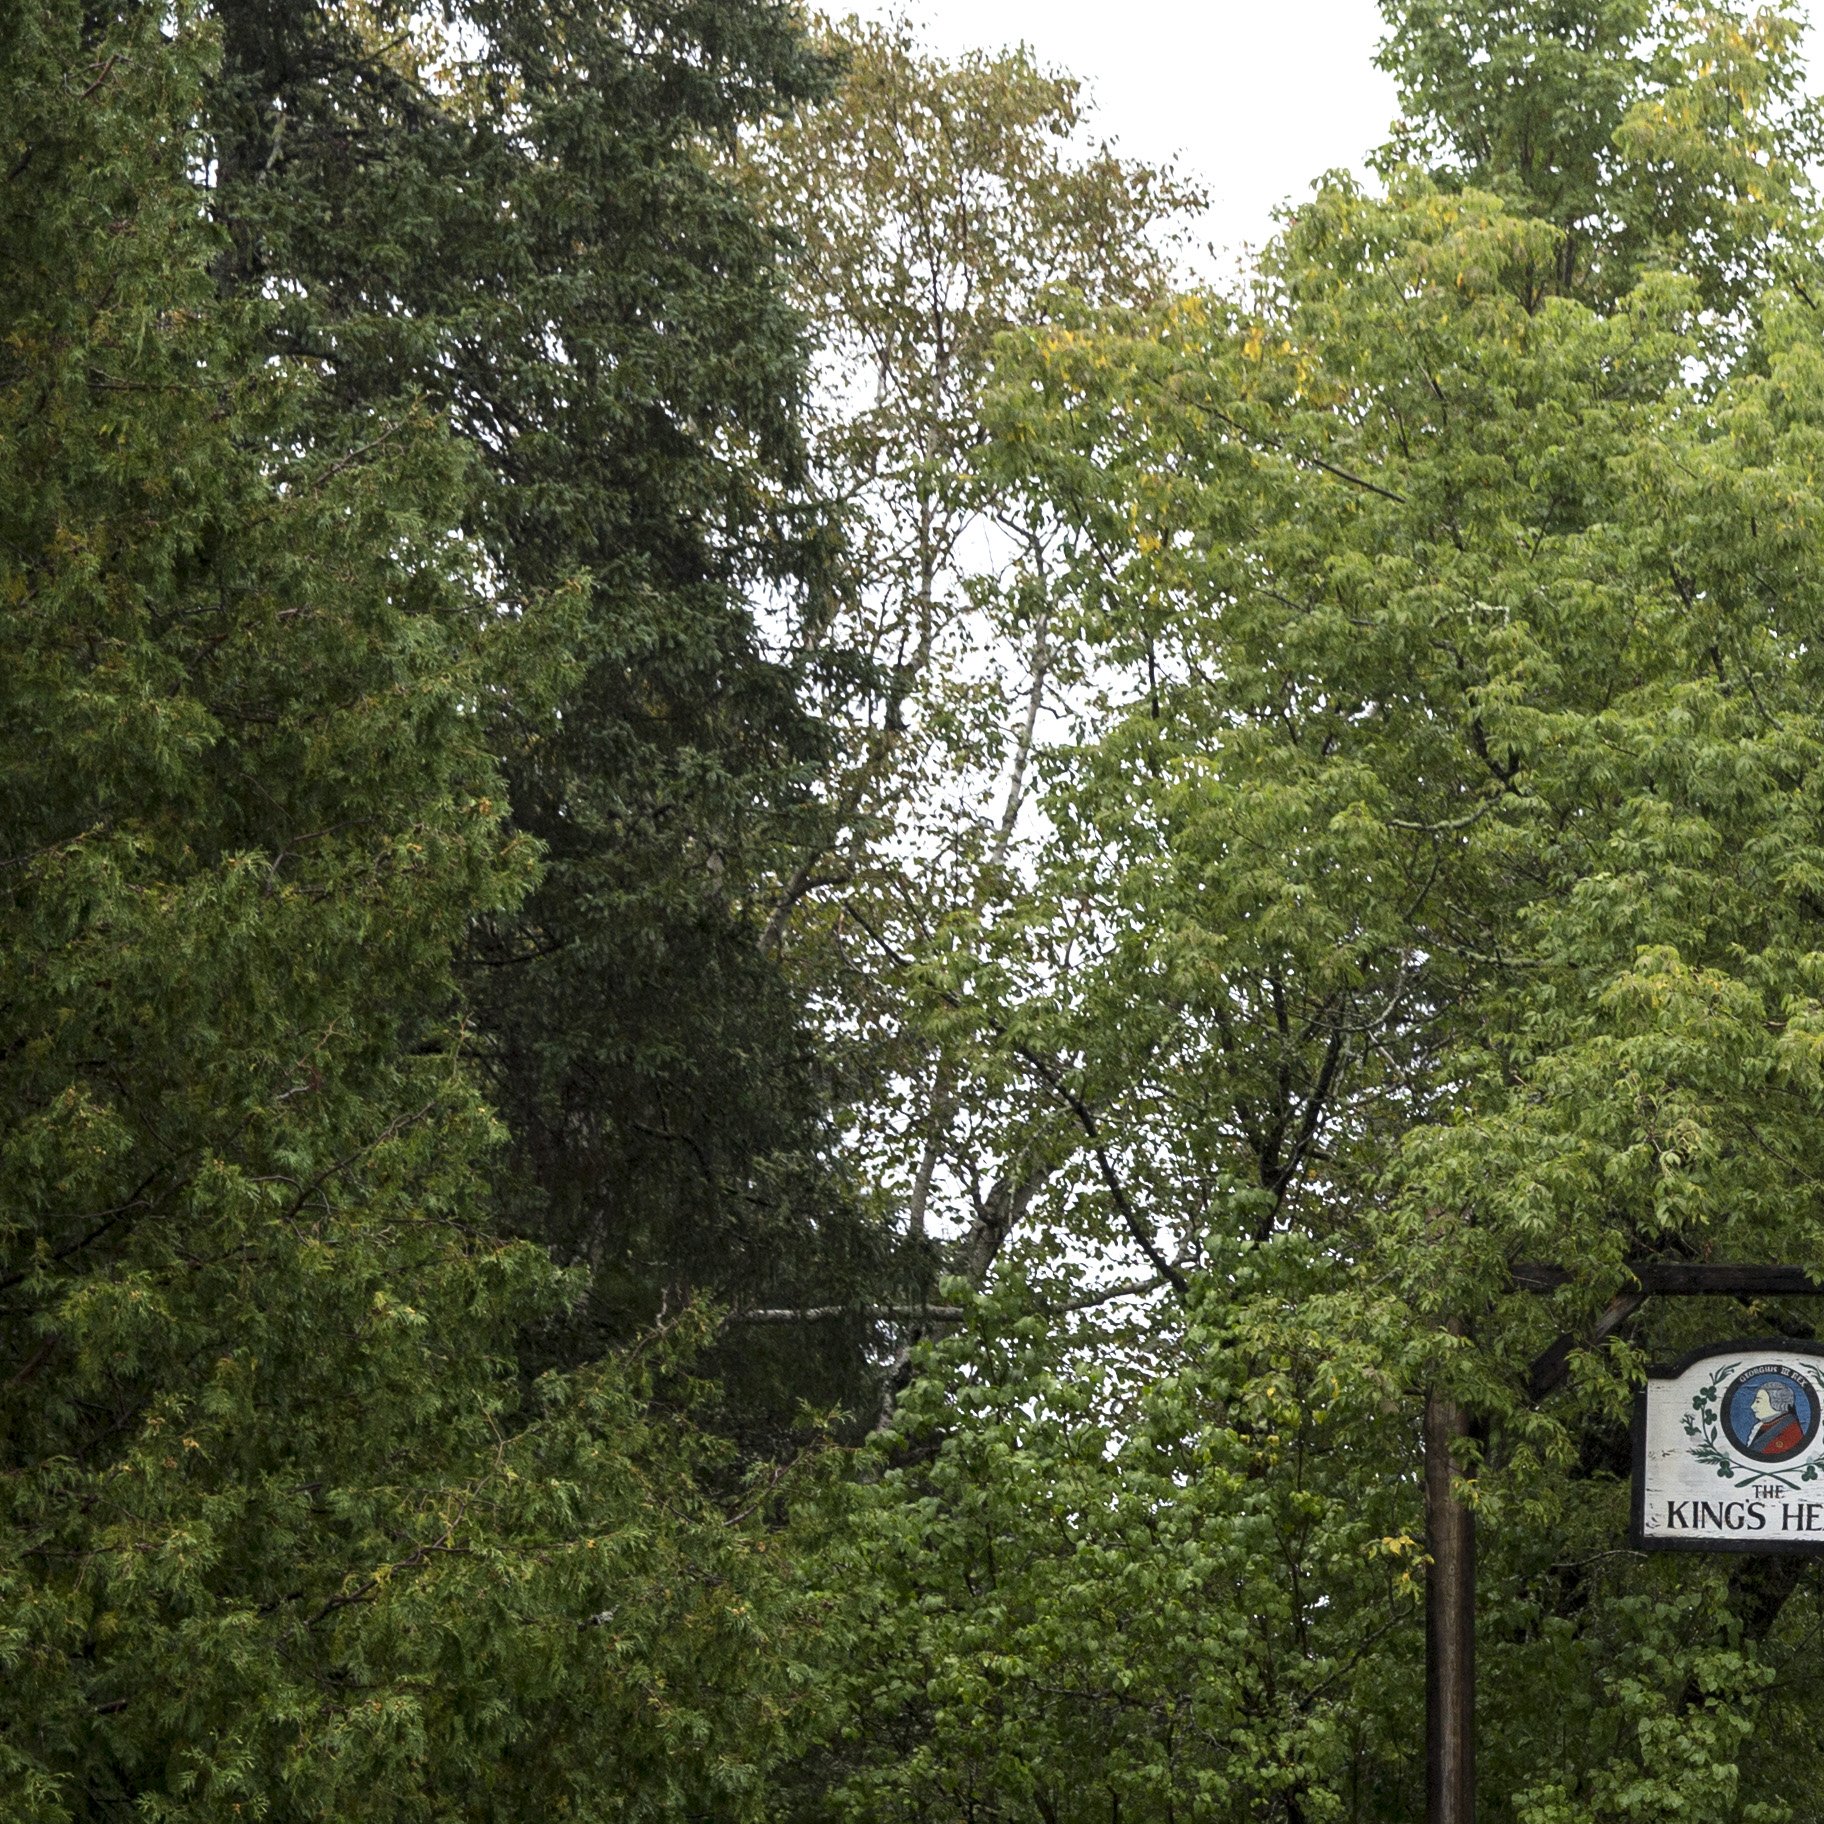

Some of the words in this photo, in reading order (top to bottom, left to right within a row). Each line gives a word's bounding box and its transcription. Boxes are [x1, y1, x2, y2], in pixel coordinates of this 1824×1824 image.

[1781, 1367, 1791, 1376] III
[1791, 1371, 1807, 1387] REX
[1752, 1484, 1786, 1499] THE
[1667, 1498, 1766, 1531] KING'S
